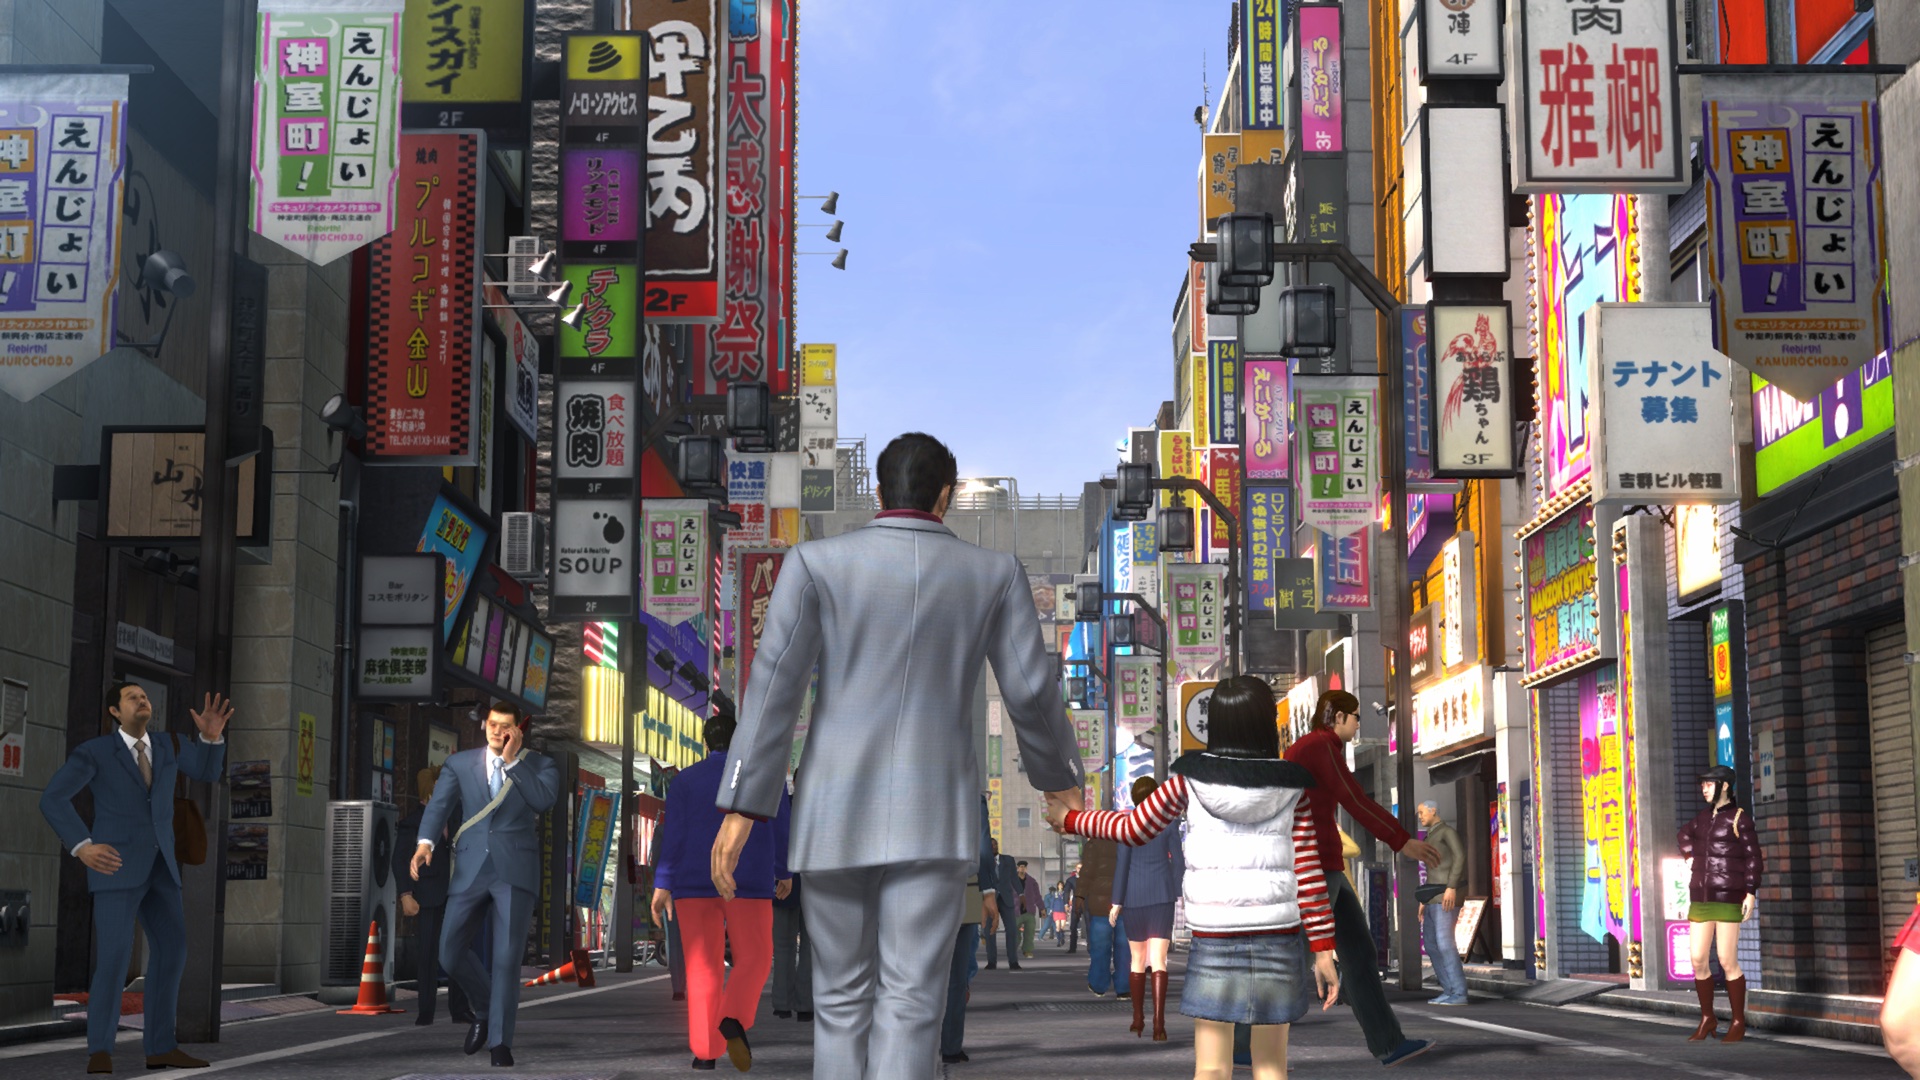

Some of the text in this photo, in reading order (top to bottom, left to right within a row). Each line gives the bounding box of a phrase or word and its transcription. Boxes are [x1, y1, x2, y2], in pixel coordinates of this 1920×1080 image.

[1565, 0, 1624, 36] 肉
[424, 0, 468, 95] イスガイ
[1256, 0, 1275, 128] 24時間営業中
[1445, 53, 1478, 65] 4F
[284, 41, 326, 192] 神室町!
[340, 31, 377, 182] えんじょい
[438, 111, 464, 127] 2F
[1539, 42, 1663, 170] 雅椰
[595, 132, 610, 143] 4F
[1316, 130, 1332, 150] 3F
[415, 148, 438, 165] 焼肉
[47, 121, 92, 295] えんじょい
[272, 203, 379, 213] セキュリティカメラ作動中
[582, 157, 606, 237] リッチモンド
[607, 169, 621, 226] CLUB
[1810, 122, 1847, 295] えんじょい
[713, 60, 764, 380] 大感謝祭
[1737, 133, 1791, 306] 神室町!
[593, 244, 607, 254] 4F
[406, 175, 441, 400] プルコギ金山
[645, 287, 687, 313] 2F
[582, 267, 619, 357] テレクラ
[1739, 320, 1863, 330] セキュリティカメラ作動中
[590, 363, 606, 374] 4F
[1455, 350, 1506, 363] あいらぶ
[1612, 360, 1723, 388] テナント
[805, 391, 832, 421] ことぶき
[1221, 342, 1237, 442] 24時間営業中
[1462, 366, 1500, 446] 鶏ちゃん
[1640, 396, 1698, 424] 募集
[567, 393, 606, 468] 焼肉
[605, 393, 626, 467] 食べ放題
[1346, 399, 1364, 490] えんじょい
[1311, 406, 1337, 496] 神室町!
[1461, 453, 1493, 466] 3F
[154, 458, 203, 512] 山水
[587, 483, 602, 494] 3F
[729, 460, 766, 481] 快適
[1405, 469, 1429, 479] ゲーム
[801, 484, 833, 499] ギリシア
[728, 503, 766, 525] 高速
[558, 557, 623, 574] SOUP
[654, 523, 674, 593] 神室町!
[680, 518, 697, 589] えんじょい
[367, 592, 430, 602] コスモポリタン
[388, 580, 404, 589] Bar
[1294, 577, 1314, 587] じゅてー
[585, 602, 597, 613] 2F
[751, 557, 774, 649] パチ
[1178, 583, 1198, 643] 神室町!
[1201, 580, 1214, 641] えんじょい
[364, 659, 427, 676] 麻雀倶楽部
[1140, 667, 1151, 713] えんじょい
